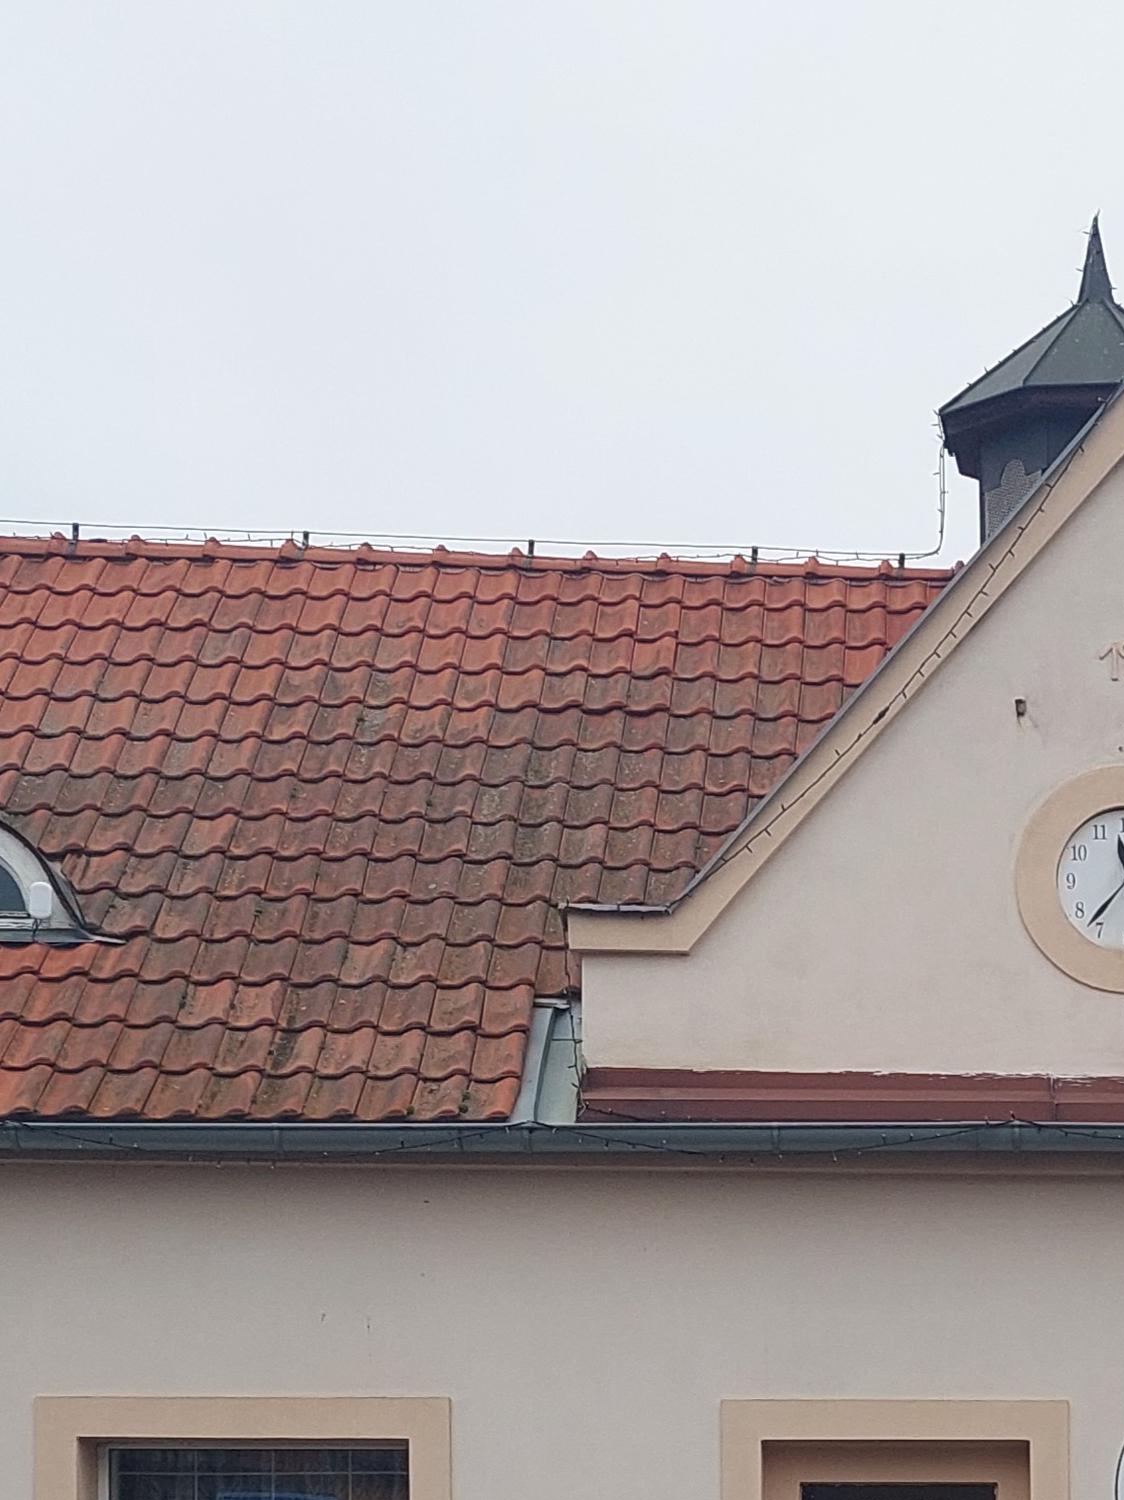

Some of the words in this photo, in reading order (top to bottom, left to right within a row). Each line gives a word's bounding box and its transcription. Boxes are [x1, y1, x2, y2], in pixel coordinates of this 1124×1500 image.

[1093, 824, 1107, 840] 11
[1071, 844, 1087, 861] 10
[1066, 873, 1075, 889] 9
[1075, 902, 1085, 919] 8
[1095, 922, 1104, 938] 7
